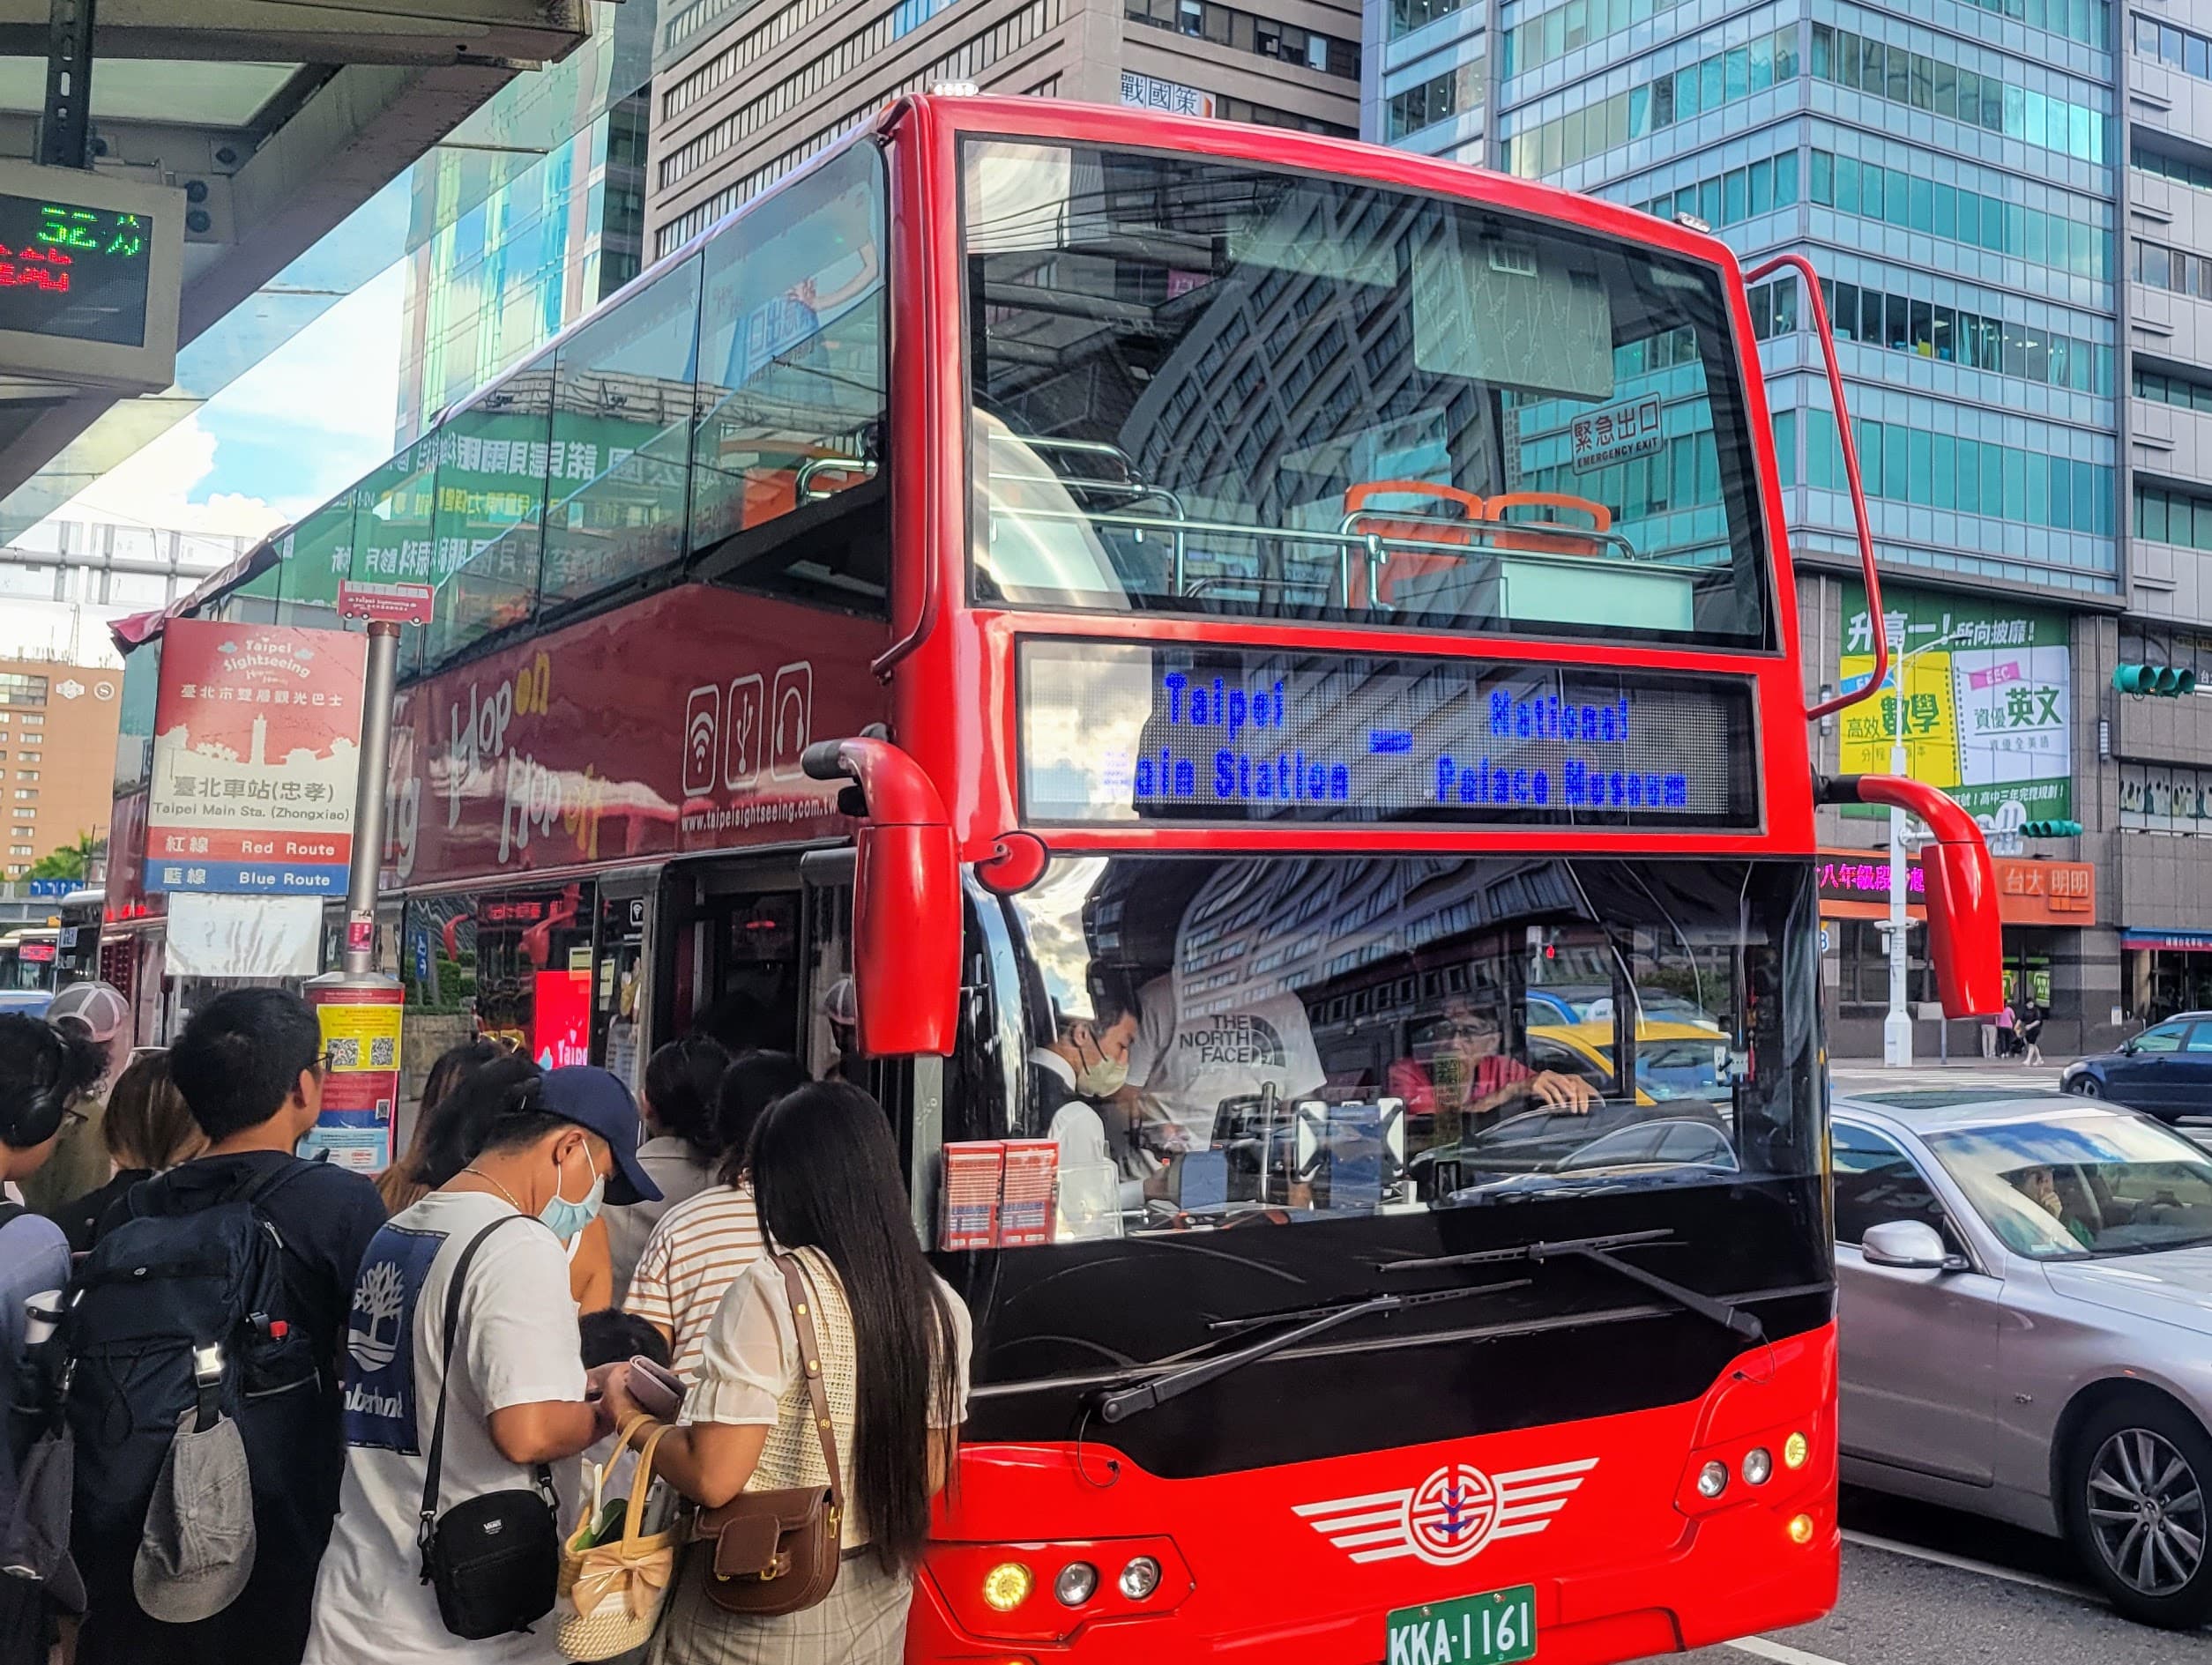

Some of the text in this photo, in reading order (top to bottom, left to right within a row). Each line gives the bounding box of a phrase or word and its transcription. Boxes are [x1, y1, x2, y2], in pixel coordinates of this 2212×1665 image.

[1121, 73, 1197, 115] 戰國策
[1575, 402, 1659, 454] 緊急出口
[1577, 437, 1658, 468] EMERGENCY EXIT
[245, 639, 292, 655] Taipei
[223, 654, 311, 679] Sightseeing
[1985, 666, 2012, 686] EEC
[180, 684, 344, 707] 臺北市雙層觀光巴士
[1164, 672, 1285, 745] Taipei
[1489, 689, 1629, 742] National
[448, 650, 551, 831] Hop on
[1213, 746, 1350, 800] Station
[1436, 753, 1688, 807] Palace Museum
[173, 776, 334, 804] 臺北車站(忠孝)
[153, 802, 350, 822] Taipei Main Sta. (Zhongxiao)
[498, 746, 562, 865] Hop
[681, 795, 838, 833] www.taipeisightseeing.com.tw
[164, 835, 209, 854] 紅線
[242, 840, 336, 857] Red Route
[162, 866, 206, 885] 藍線
[239, 871, 331, 887] Blue Route
[2007, 867, 2045, 896] 台大
[1209, 1014, 1249, 1030] THE
[1179, 1029, 1250, 1050] NORTH
[1200, 1045, 1251, 1064] FACE
